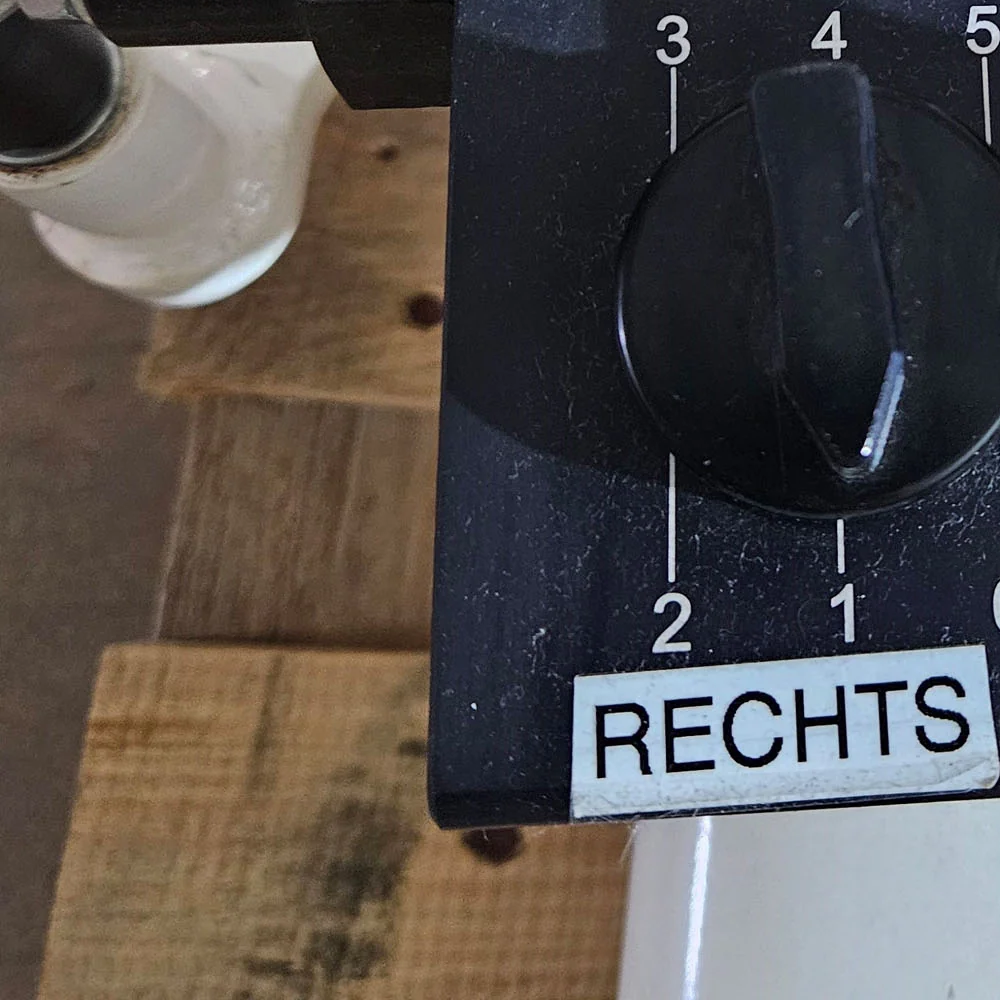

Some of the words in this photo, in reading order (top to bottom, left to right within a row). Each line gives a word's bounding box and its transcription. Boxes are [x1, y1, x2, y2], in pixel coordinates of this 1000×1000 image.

[656, 14, 691, 65] 3
[811, 10, 848, 60] 4
[965, 5, 1000, 55] 5
[652, 592, 692, 654] 2
[830, 583, 855, 643] 1
[594, 675, 971, 780] RECHTS
